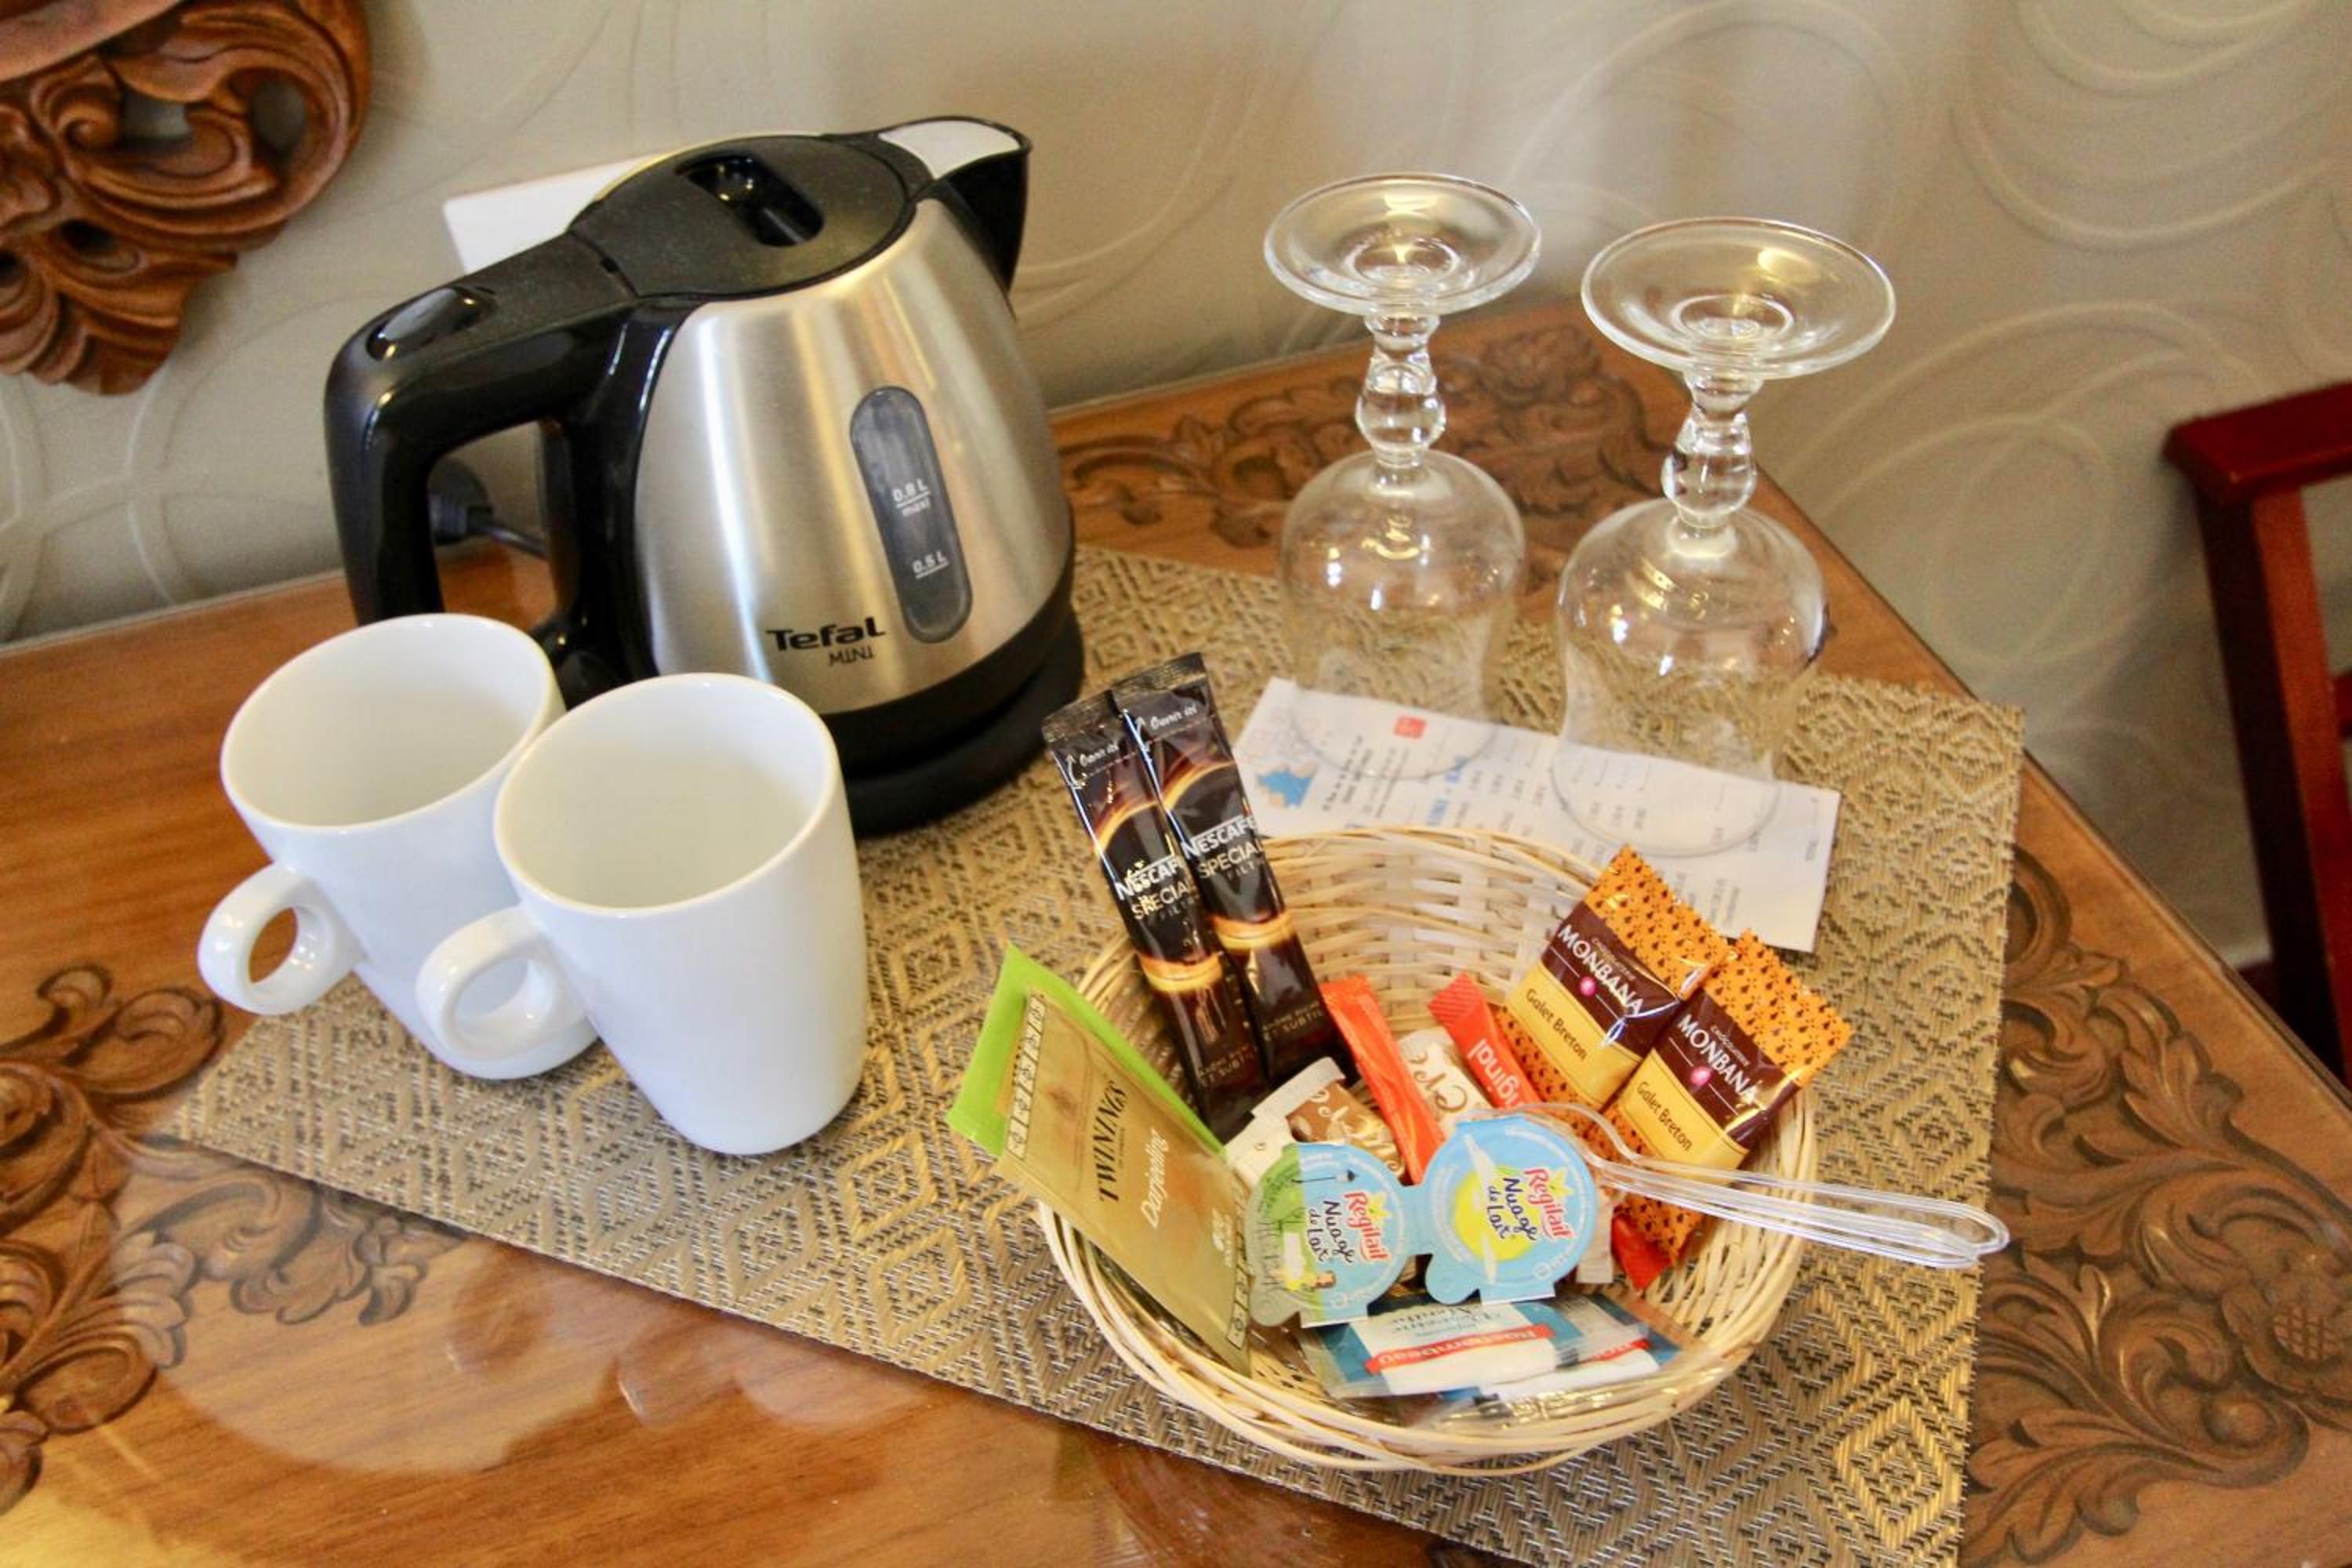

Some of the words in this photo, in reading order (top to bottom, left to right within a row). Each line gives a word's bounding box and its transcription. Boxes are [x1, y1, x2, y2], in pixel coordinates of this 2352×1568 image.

[892, 483, 916, 502] 0.8
[917, 479, 928, 492] L
[912, 556, 935, 574] 0.5
[937, 551, 946, 562] L
[766, 617, 886, 651] Tefal
[828, 645, 874, 666] MINI
[1115, 853, 1185, 901] NESCAF
[1557, 924, 1643, 1015] MONBANA
[1525, 988, 1555, 1021] Galet
[1554, 1016, 1588, 1061] Breton
[1468, 1039, 1520, 1105] iginal
[1676, 1014, 1760, 1103] MONBANA
[1093, 1079, 1127, 1202] TWININGS
[1635, 1081, 1662, 1116] Galet
[1659, 1109, 1694, 1152] Breton
[1488, 1185, 1501, 1202] de
[1503, 1178, 1537, 1241] Nuage
[1323, 1200, 1356, 1264] Nuage
